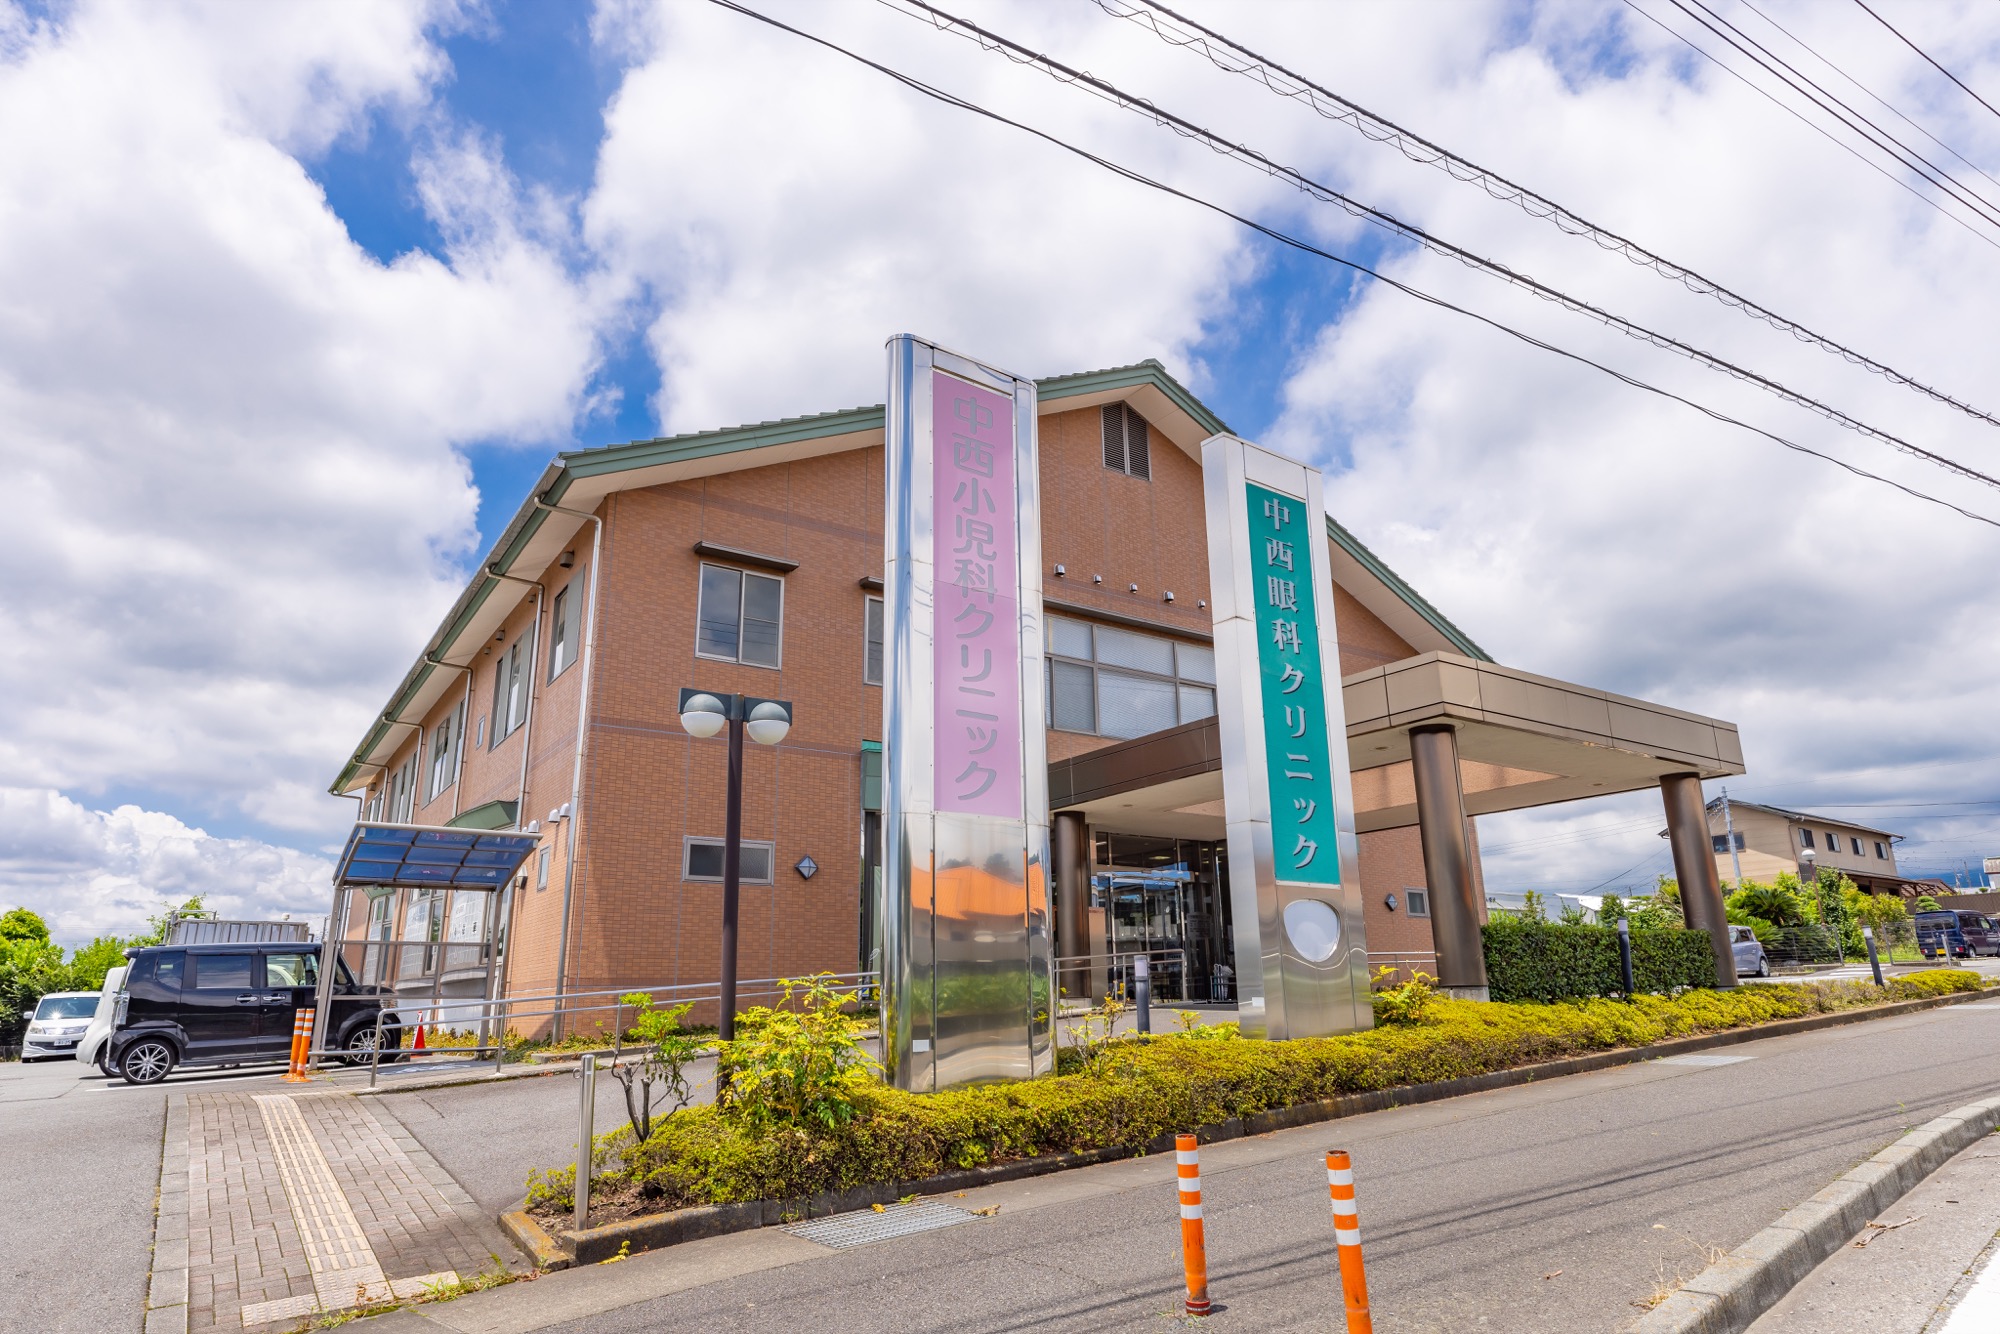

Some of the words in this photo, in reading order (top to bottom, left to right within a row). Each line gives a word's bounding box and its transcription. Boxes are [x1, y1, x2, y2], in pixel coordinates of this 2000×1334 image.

[953, 396, 998, 800] 中西小児科クリニック
[1264, 498, 1318, 869] 中西眼科クリニック
